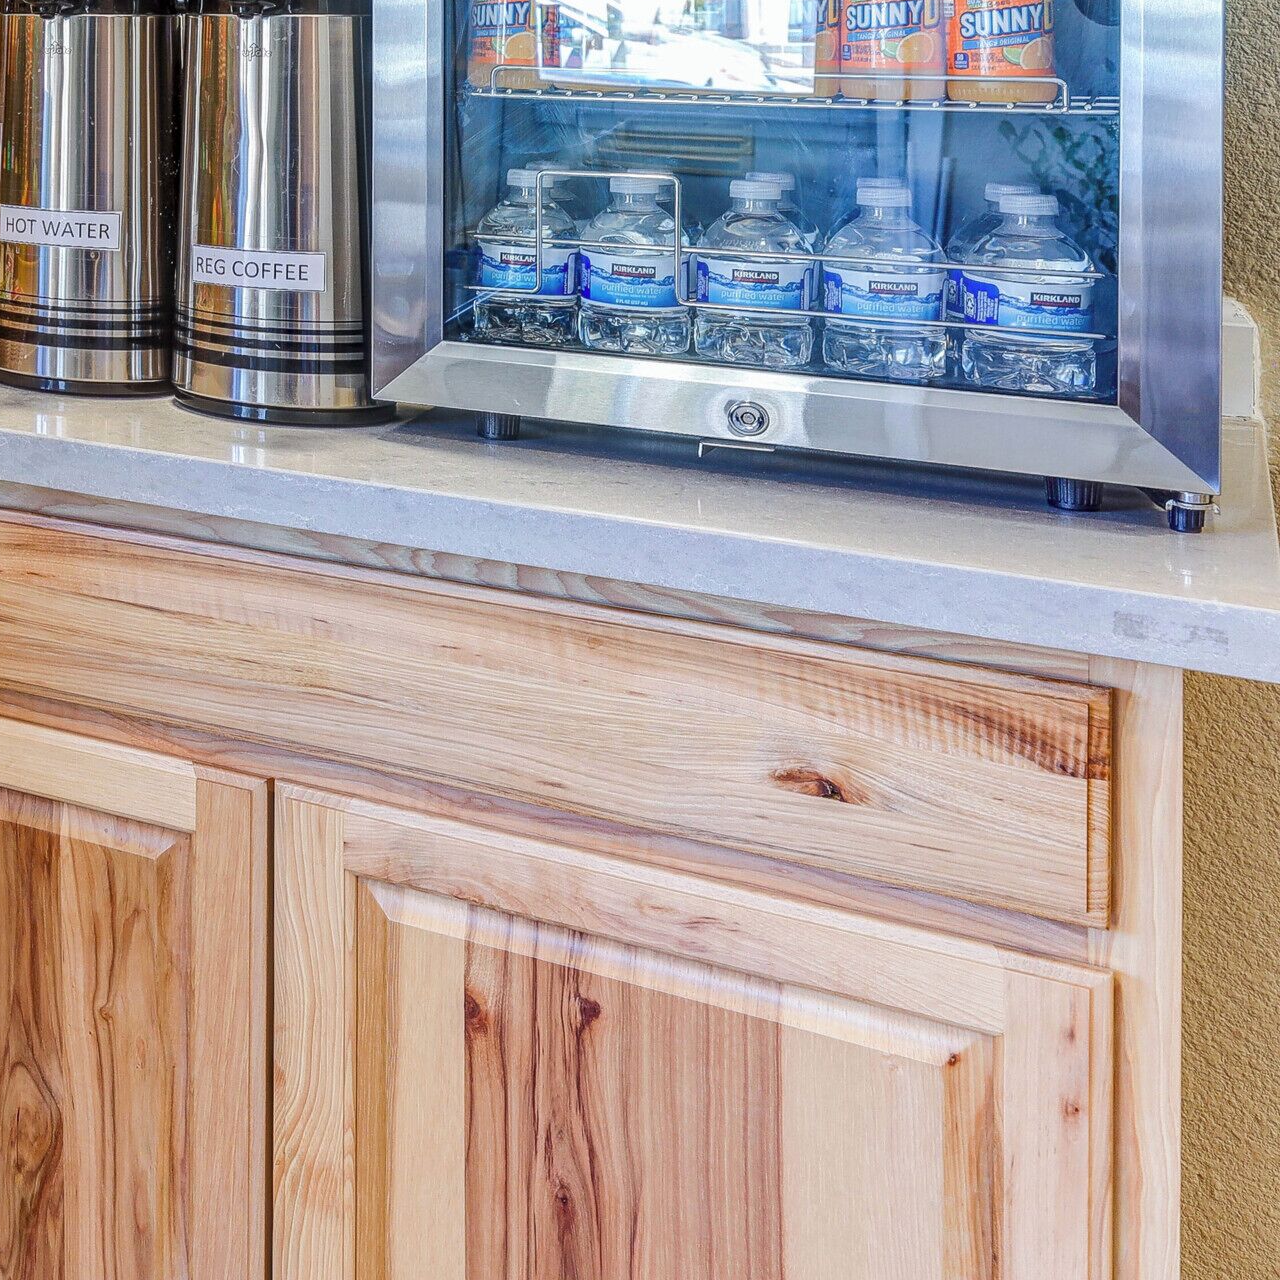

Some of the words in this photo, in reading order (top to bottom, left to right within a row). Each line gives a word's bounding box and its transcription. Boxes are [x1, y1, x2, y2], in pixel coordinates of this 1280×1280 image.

[999, 35, 1030, 45] ORIGINAL
[5, 216, 37, 235] HOT
[42, 219, 110, 239] WATER
[502, 253, 536, 263] KIRKLAN
[195, 255, 225, 276] REG
[232, 261, 310, 282] COFFEE
[613, 263, 655, 275] KIRKLAND
[734, 269, 778, 280] KIRKLAND
[601, 282, 635, 294] purified
[636, 285, 662, 295] water
[871, 281, 917, 292] KIRKLAND
[721, 290, 756, 302] purified
[758, 292, 786, 302] water
[1033, 293, 1080, 304] KIRKLAND
[857, 301, 895, 314] purified
[897, 304, 924, 313] water
[1016, 313, 1058, 326] purified
